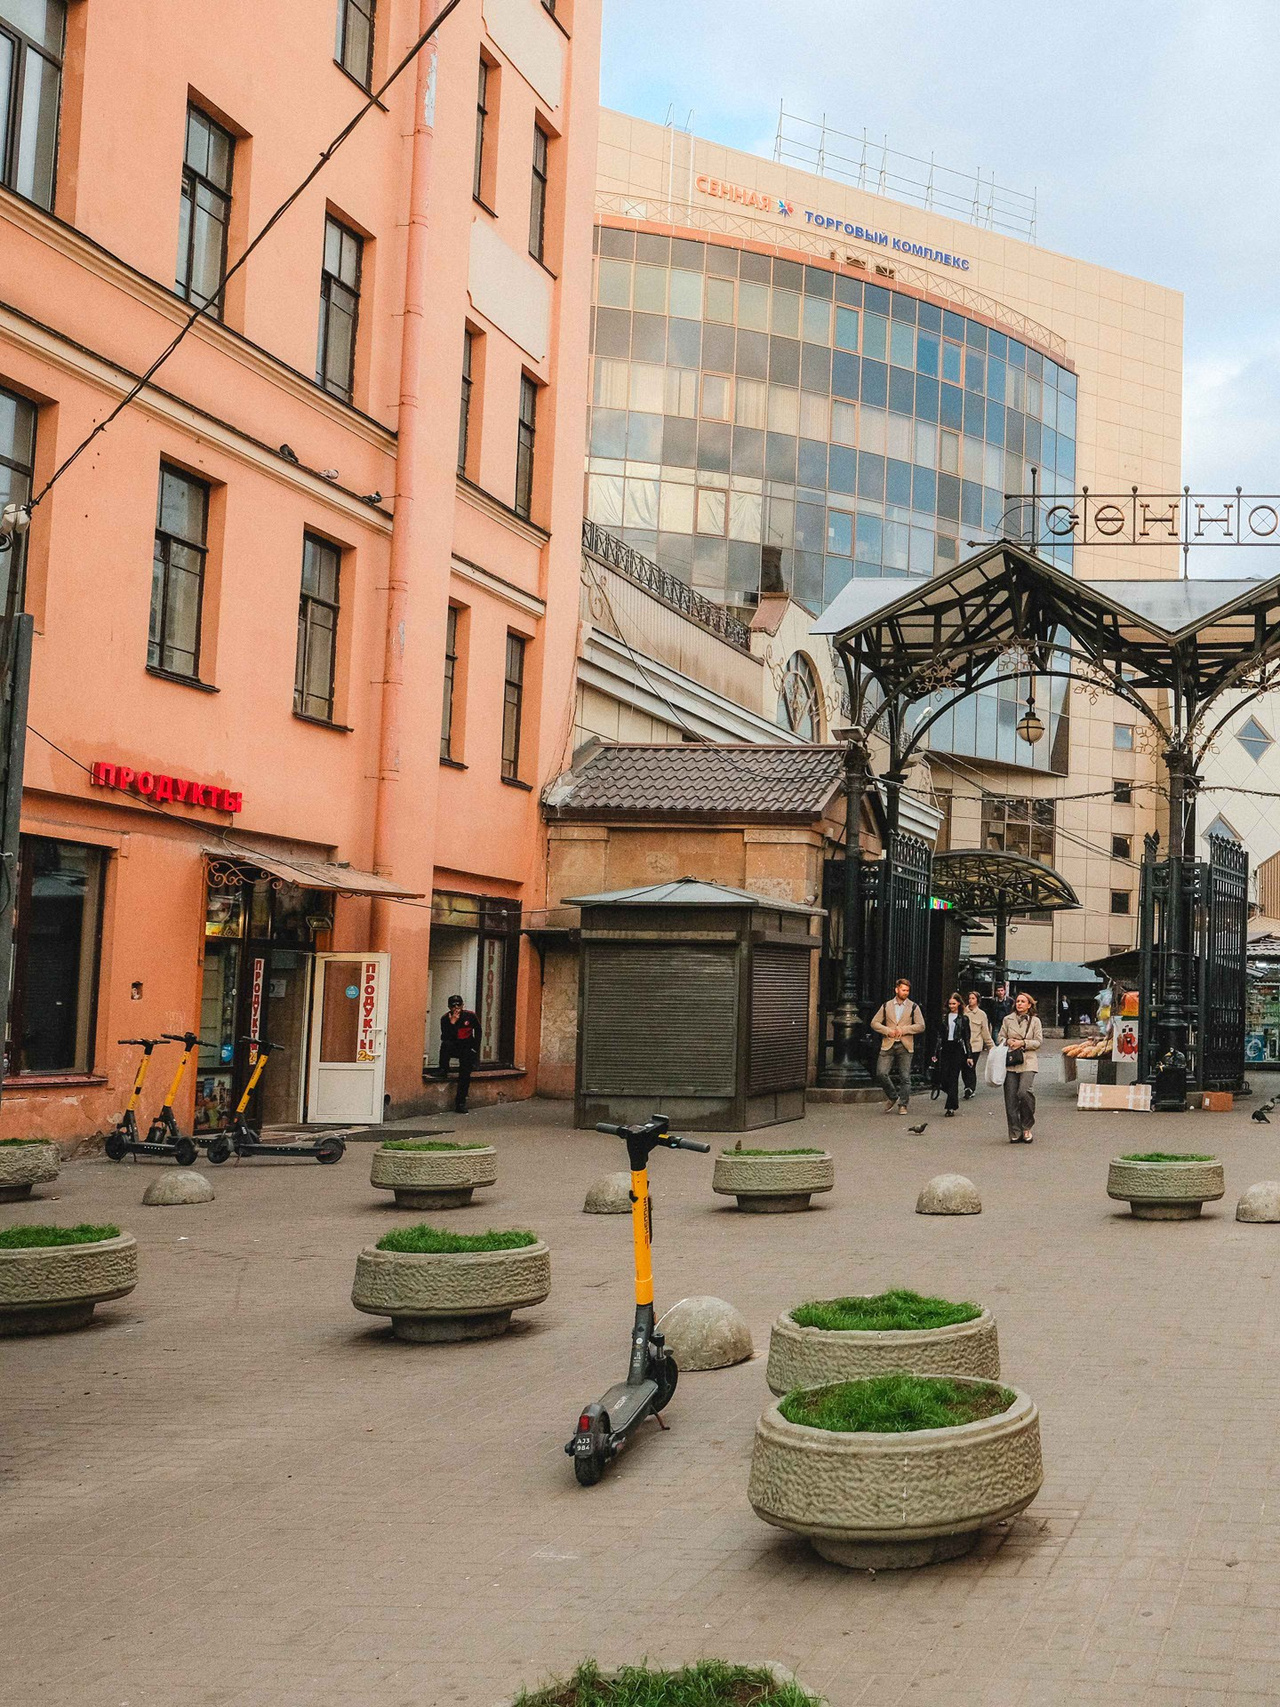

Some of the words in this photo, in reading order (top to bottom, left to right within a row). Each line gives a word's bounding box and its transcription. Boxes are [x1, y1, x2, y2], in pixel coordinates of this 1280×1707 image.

[694, 175, 772, 212] СЕННАЯ
[804, 210, 888, 246] ТОРГОВЫЙ
[892, 238, 970, 271] КОМПЛЕКС
[93, 762, 242, 813] ПРОДУКТЫ
[360, 963, 376, 1050] ПРОДУКТЫ
[357, 1050, 374, 1061] 24
